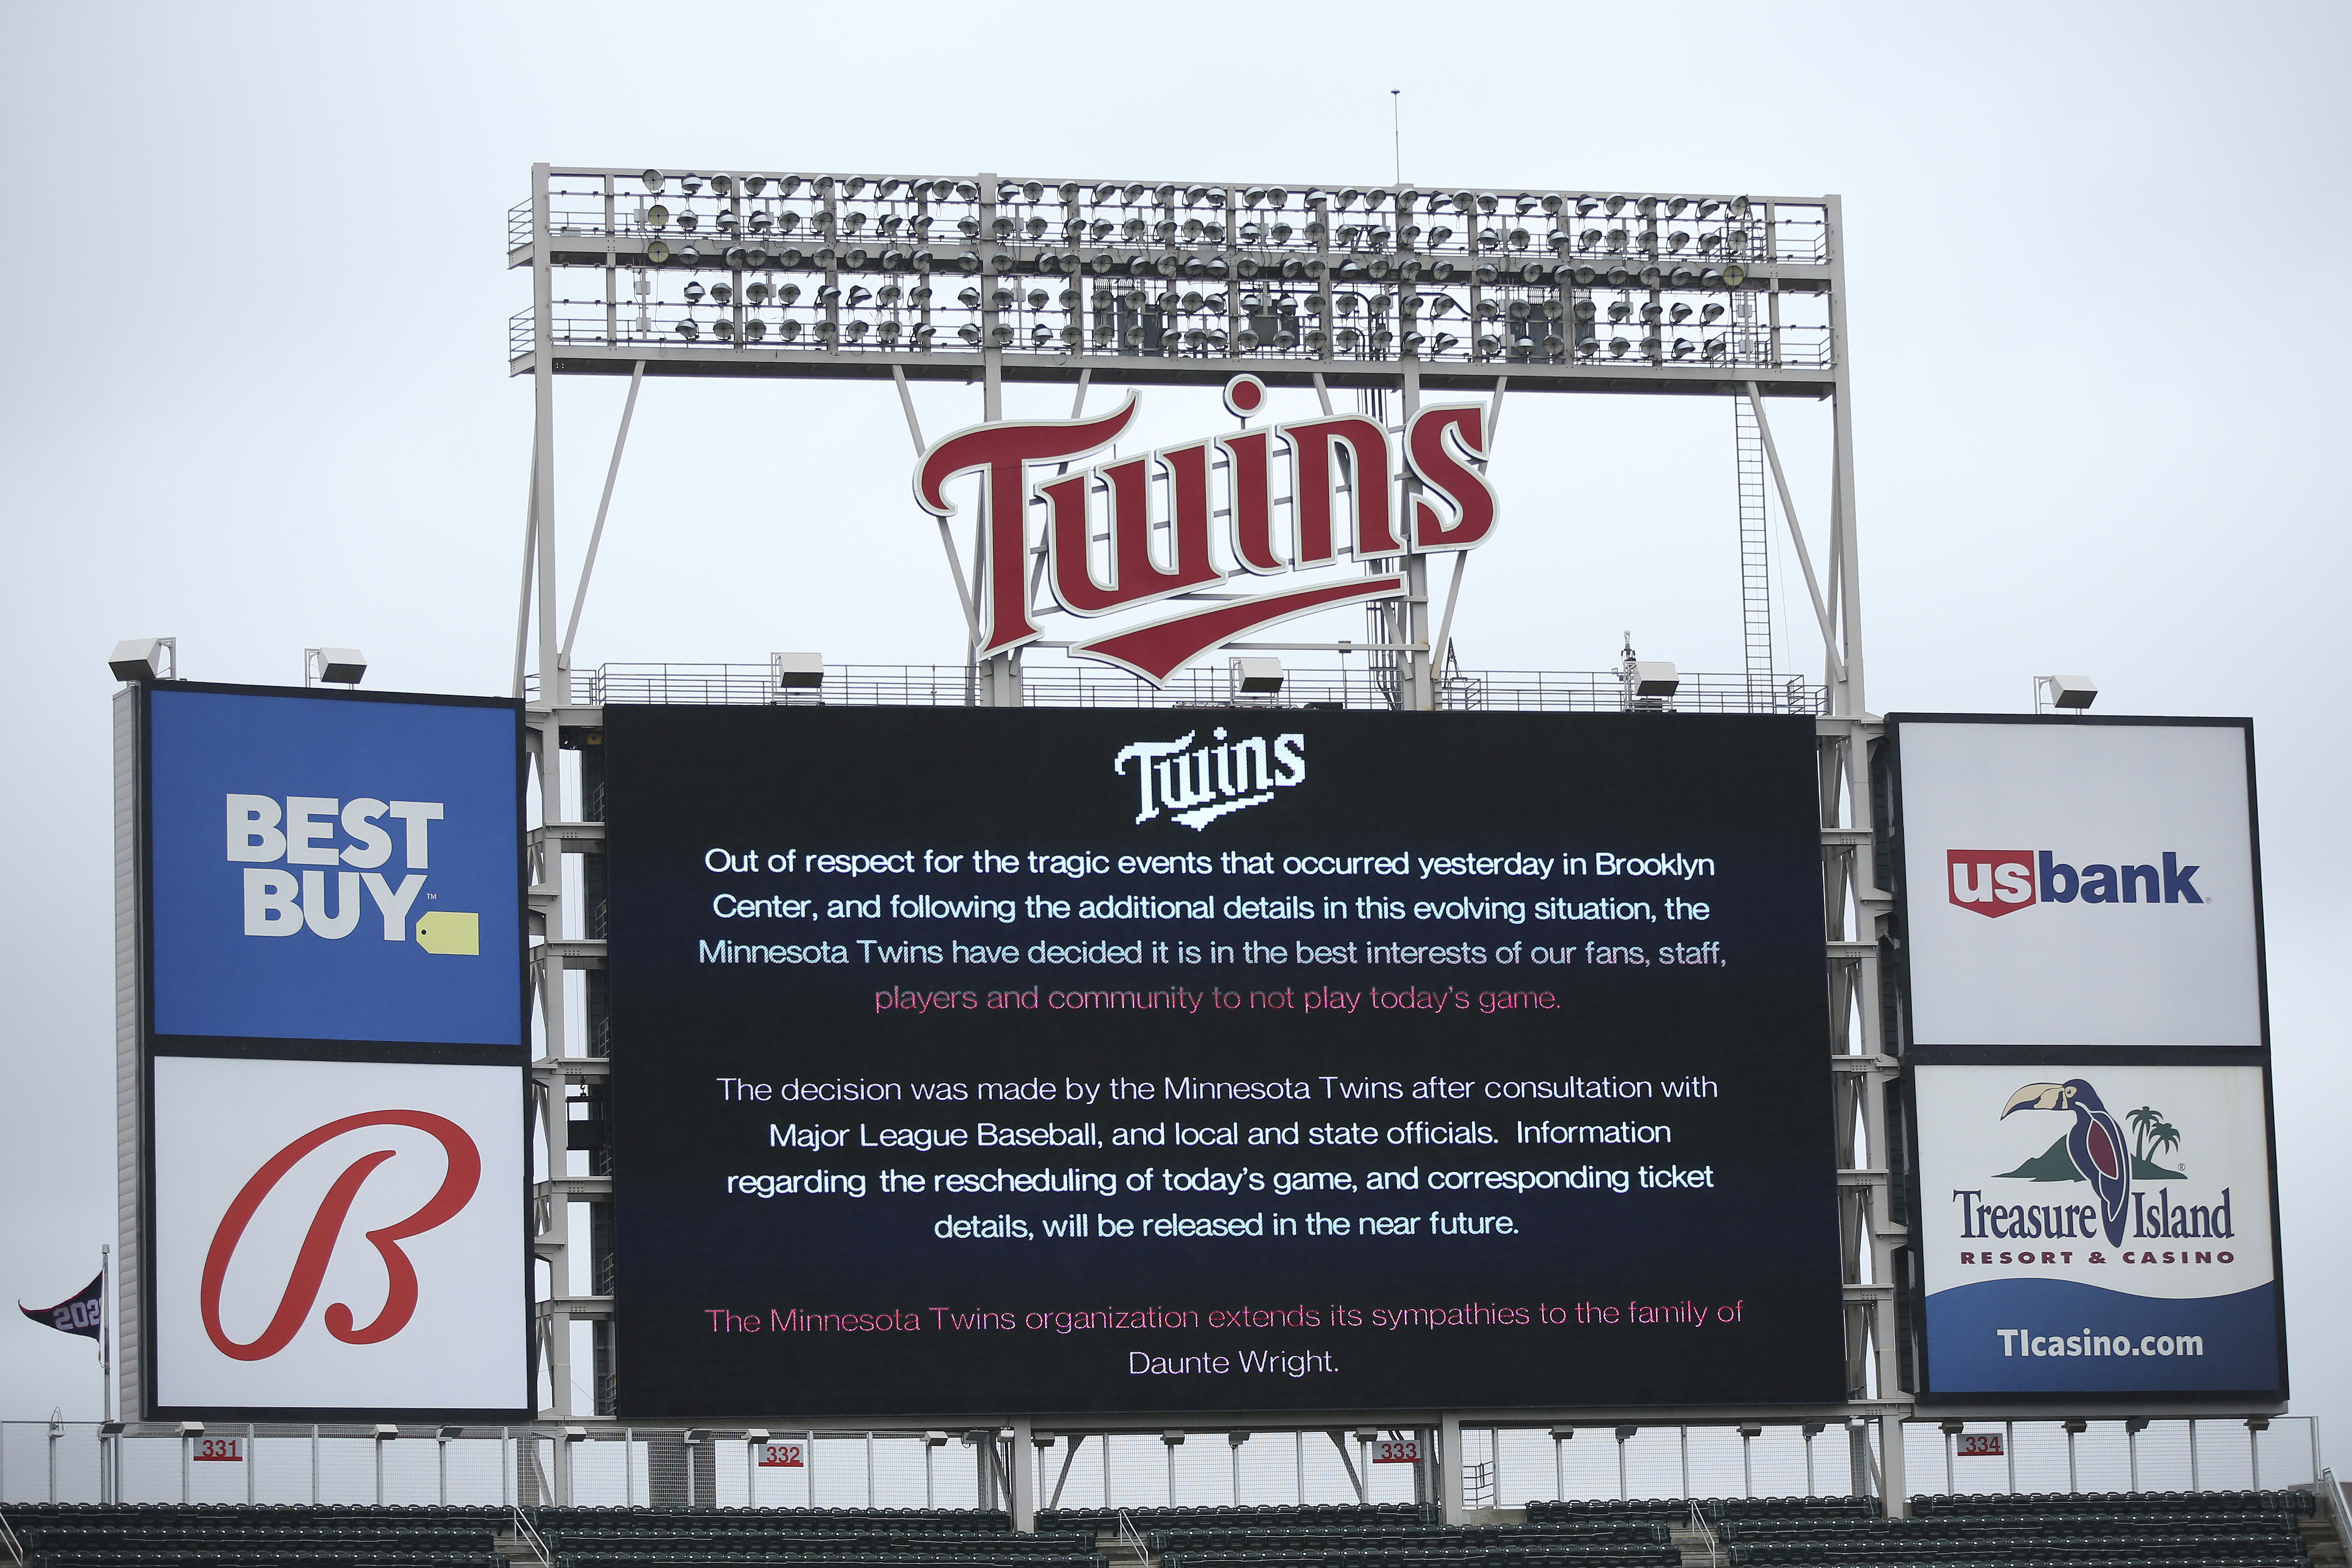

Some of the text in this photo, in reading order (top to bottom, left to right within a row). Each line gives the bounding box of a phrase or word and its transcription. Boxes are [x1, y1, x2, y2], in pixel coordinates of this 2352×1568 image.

[914, 373, 1499, 689] Twins
[1115, 727, 1306, 831] Twins
[227, 793, 444, 869] BEST
[703, 847, 1717, 881] Out of respect for the tragic events that occurred yesterday in Brooklyn
[244, 868, 428, 942] BUY
[711, 893, 1710, 925] Center, and following the additional details in this evolving situation, the
[699, 939, 1726, 968] Minnesota Twins have decided it is in the best interests of our fans, staff,
[875, 985, 978, 1014] players
[986, 985, 1039, 1009] and
[1048, 986, 1204, 1014] community
[1211, 986, 1242, 1009] to
[1250, 987, 1295, 1009] not
[1304, 985, 1362, 1014] play
[1478, 990, 1561, 1014] game.
[716, 1075, 1718, 1105] The decision was made by the Minnesota Twins after consultation with
[768, 1120, 1672, 1152] Major League Baseball, and local and state officials. Information
[726, 1169, 867, 1199] regarding
[878, 1168, 927, 1194] the
[932, 1167, 1117, 1197] rescheduling
[1124, 1167, 1156, 1193] of
[1273, 1171, 1359, 1196] game,
[1366, 1165, 1420, 1191] and
[1427, 1164, 1631, 1194] corresponding
[1637, 1164, 1715, 1189] ticket
[933, 1211, 1519, 1242] details, will be released in the near future.
[1953, 1187, 2235, 1239] Treasure Island
[201, 1109, 481, 1361] B
[1961, 1251, 2234, 1264] RESORT & CASINO
[53, 1297, 101, 1331] 202
[704, 1300, 1744, 1335] The Minnesota Twins organization extends its sympathies to the family of
[1997, 1328, 2203, 1357] TIcasino.com
[1128, 1349, 1339, 1378] Daunte Wright.
[202, 1439, 238, 1458] 331
[766, 1446, 801, 1462] 332
[1381, 1443, 1417, 1459] 333
[1965, 1436, 2001, 1452] 334
